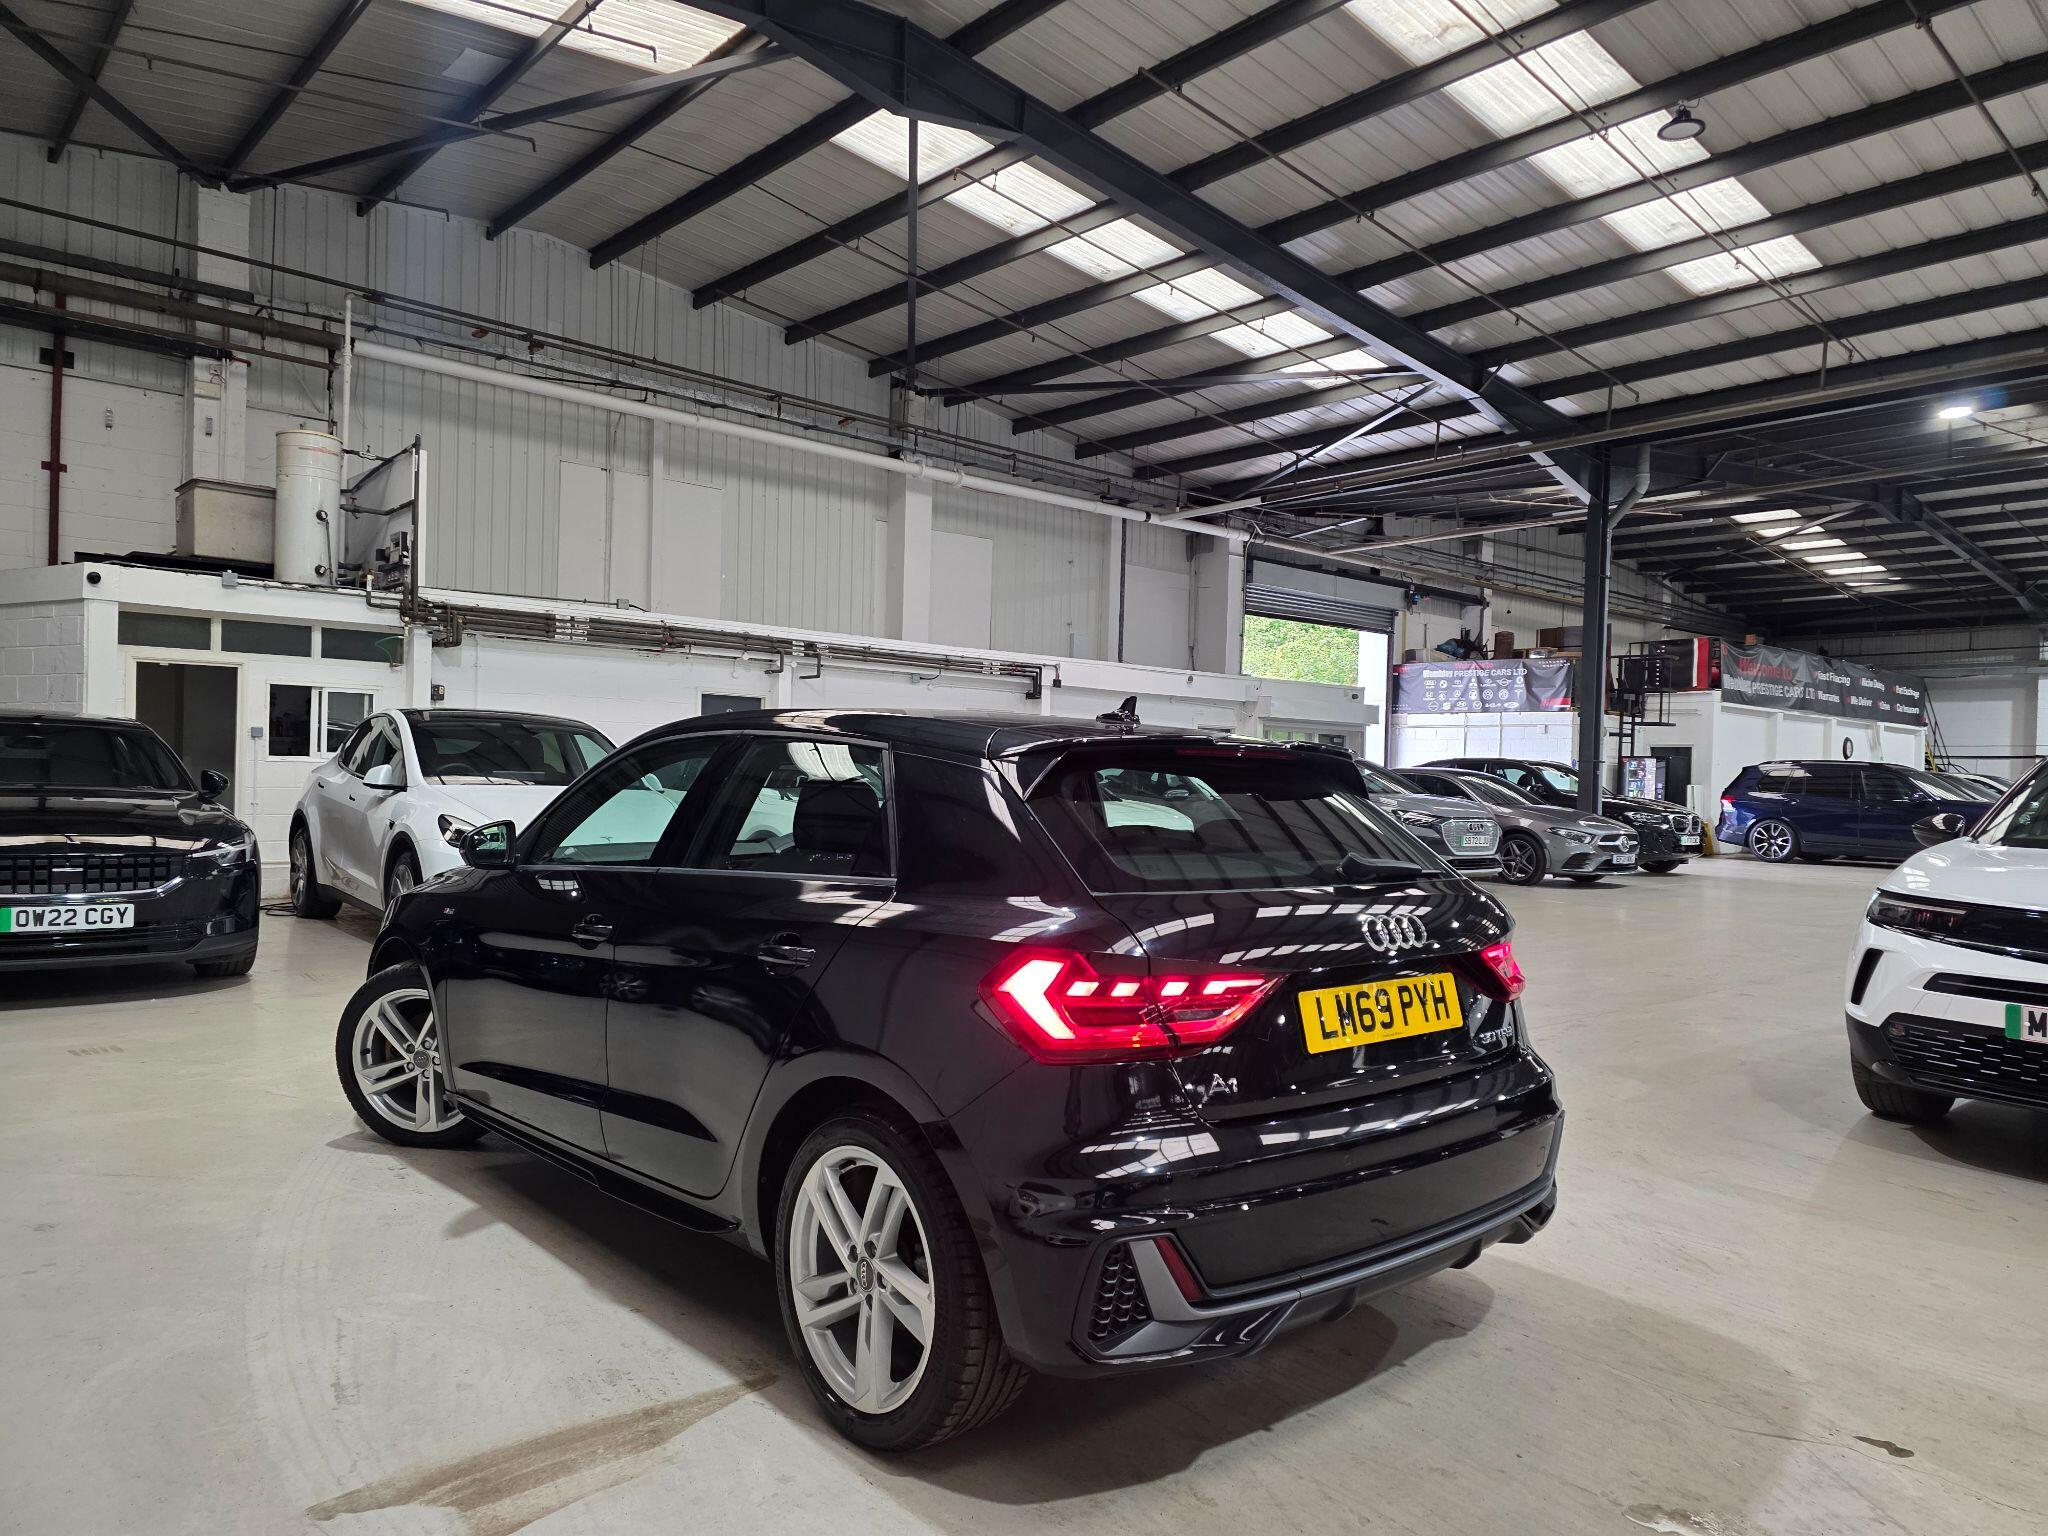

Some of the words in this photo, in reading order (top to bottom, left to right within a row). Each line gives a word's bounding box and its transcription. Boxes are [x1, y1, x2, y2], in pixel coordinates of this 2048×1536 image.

[1454, 669, 1489, 678] PRESTIGE
[1512, 668, 1528, 676] LTD
[1752, 681, 1784, 697] PRESTIGE
[1784, 685, 1804, 698] CARS
[16, 909, 77, 928] OW22
[85, 907, 129, 926] CGY
[1315, 988, 1394, 1041] LM69
[1398, 980, 1451, 1027] PYH
[1208, 1073, 1238, 1097] A1
